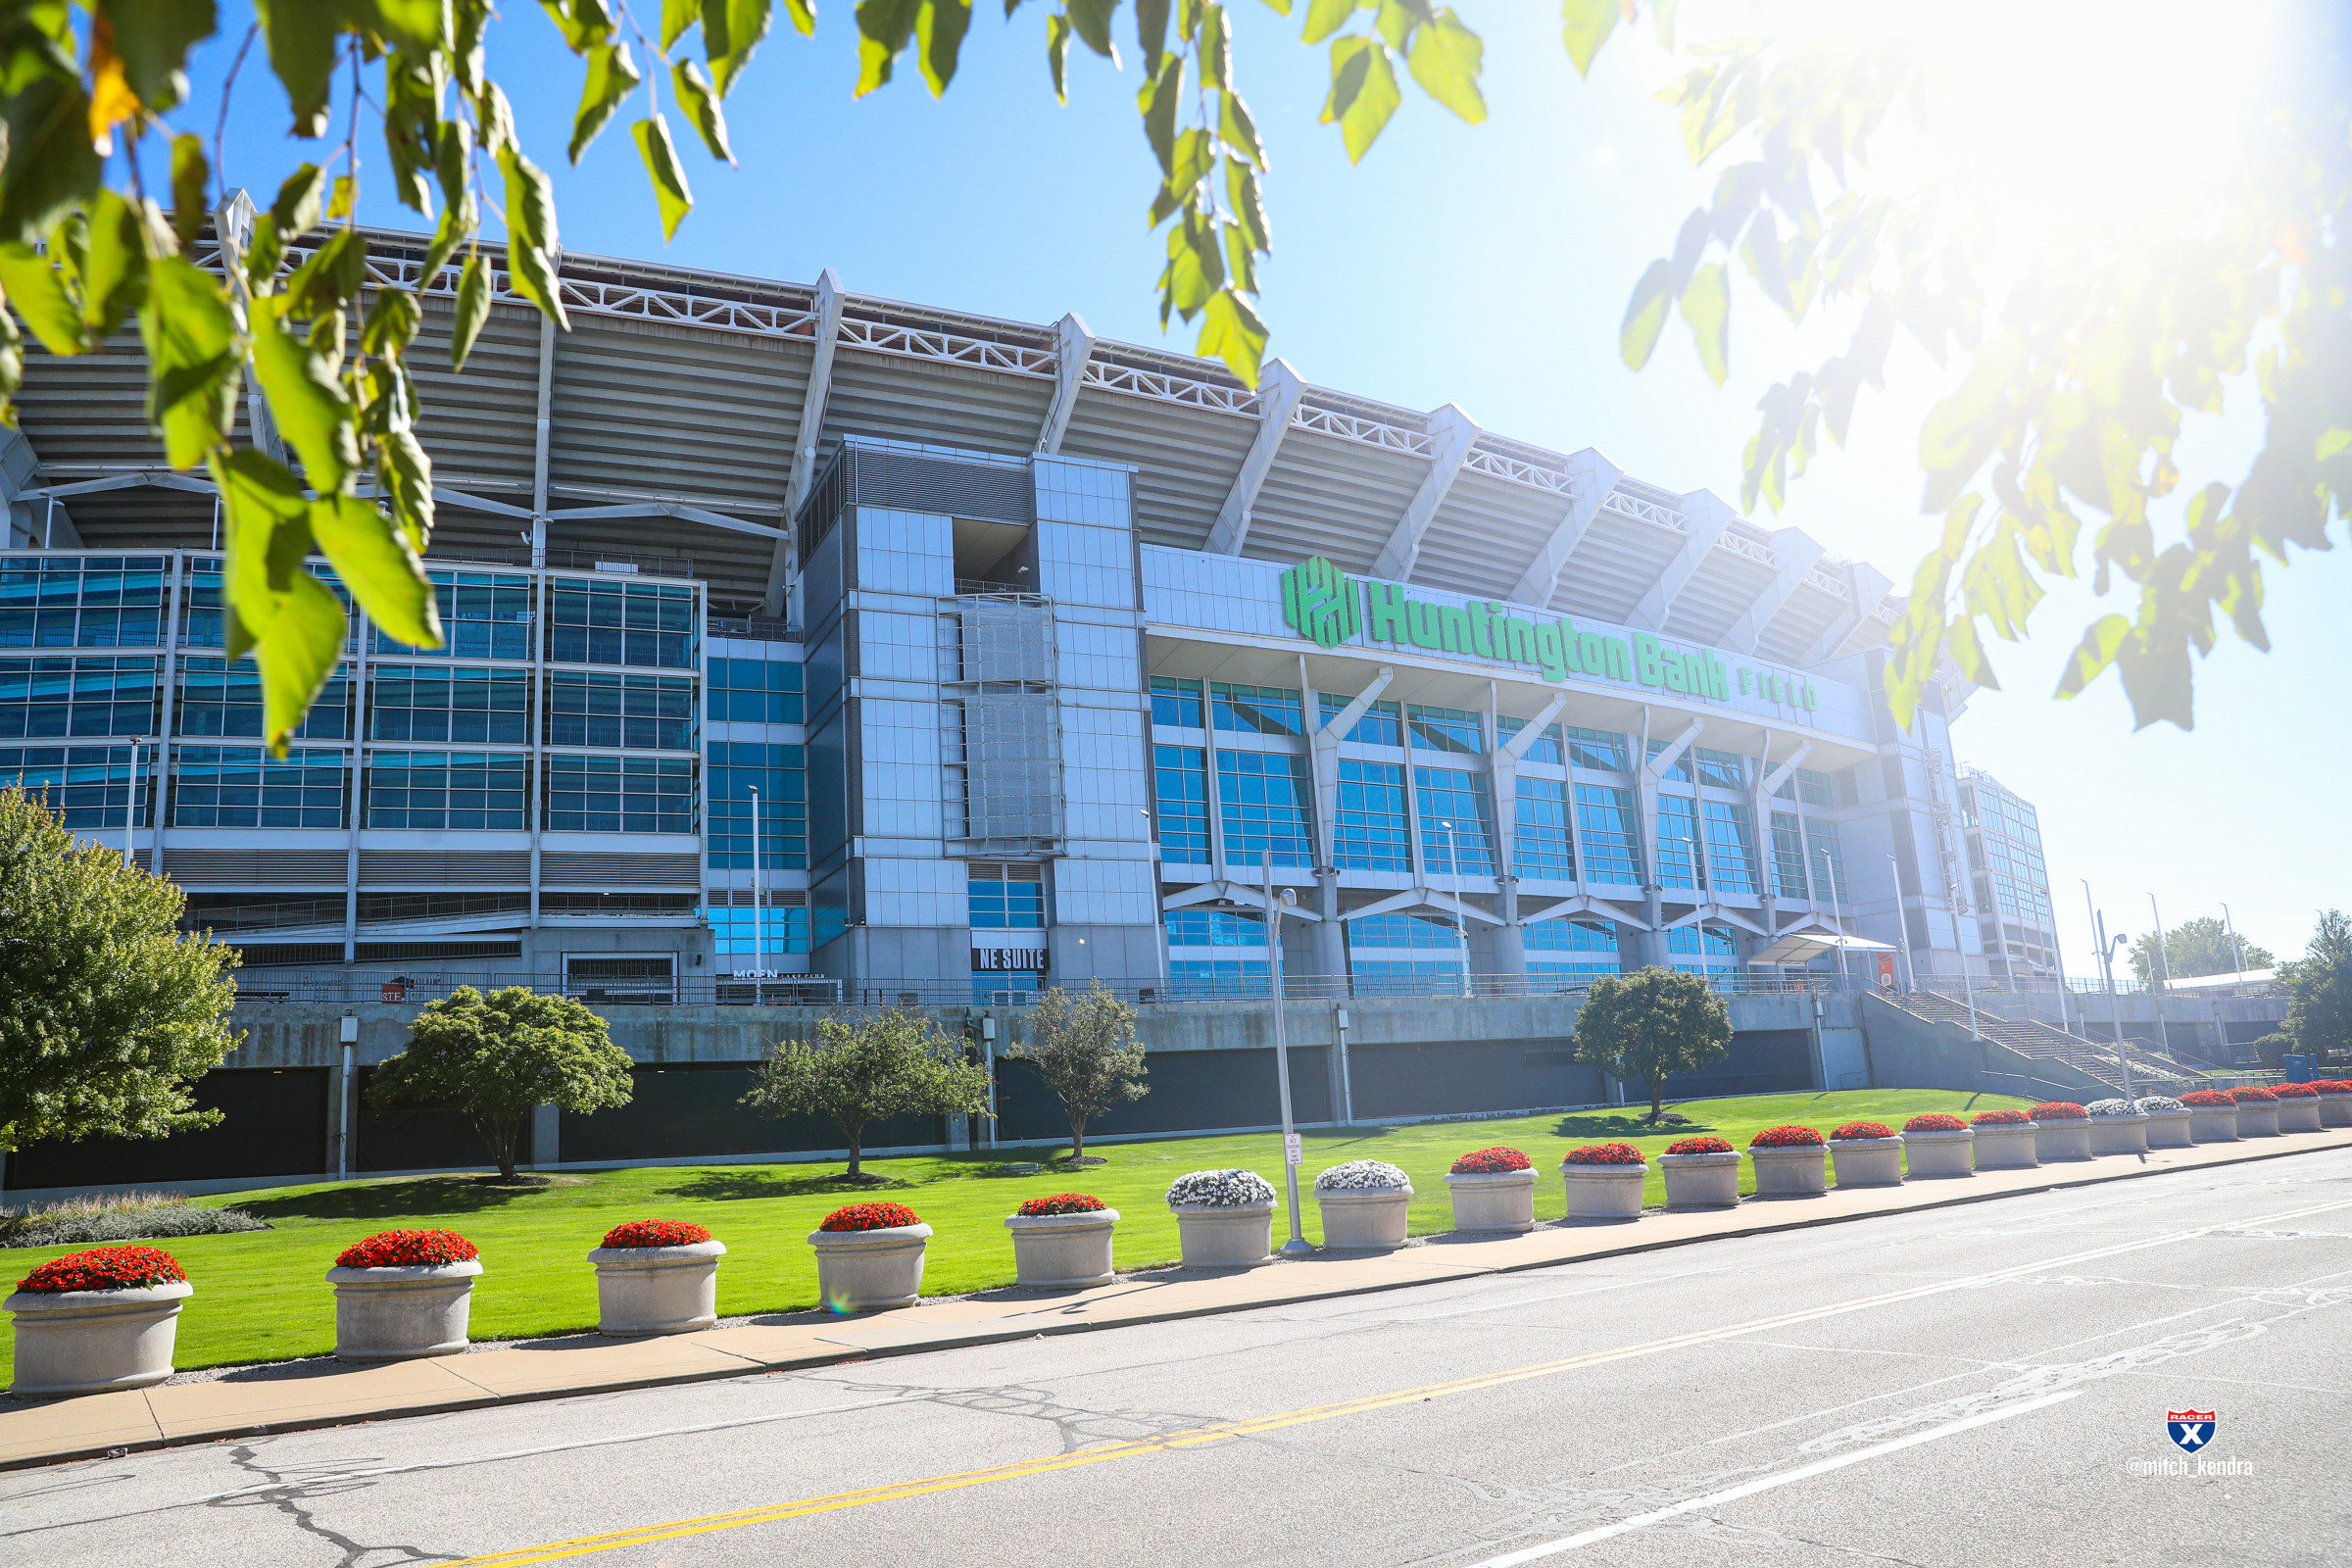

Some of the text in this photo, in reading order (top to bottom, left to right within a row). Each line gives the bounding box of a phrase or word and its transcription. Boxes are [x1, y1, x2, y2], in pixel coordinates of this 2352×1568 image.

[1370, 580, 1818, 712] Huntington Bank FIELD
[980, 949, 1045, 969] NE SUITE
[733, 968, 778, 980] MOEN
